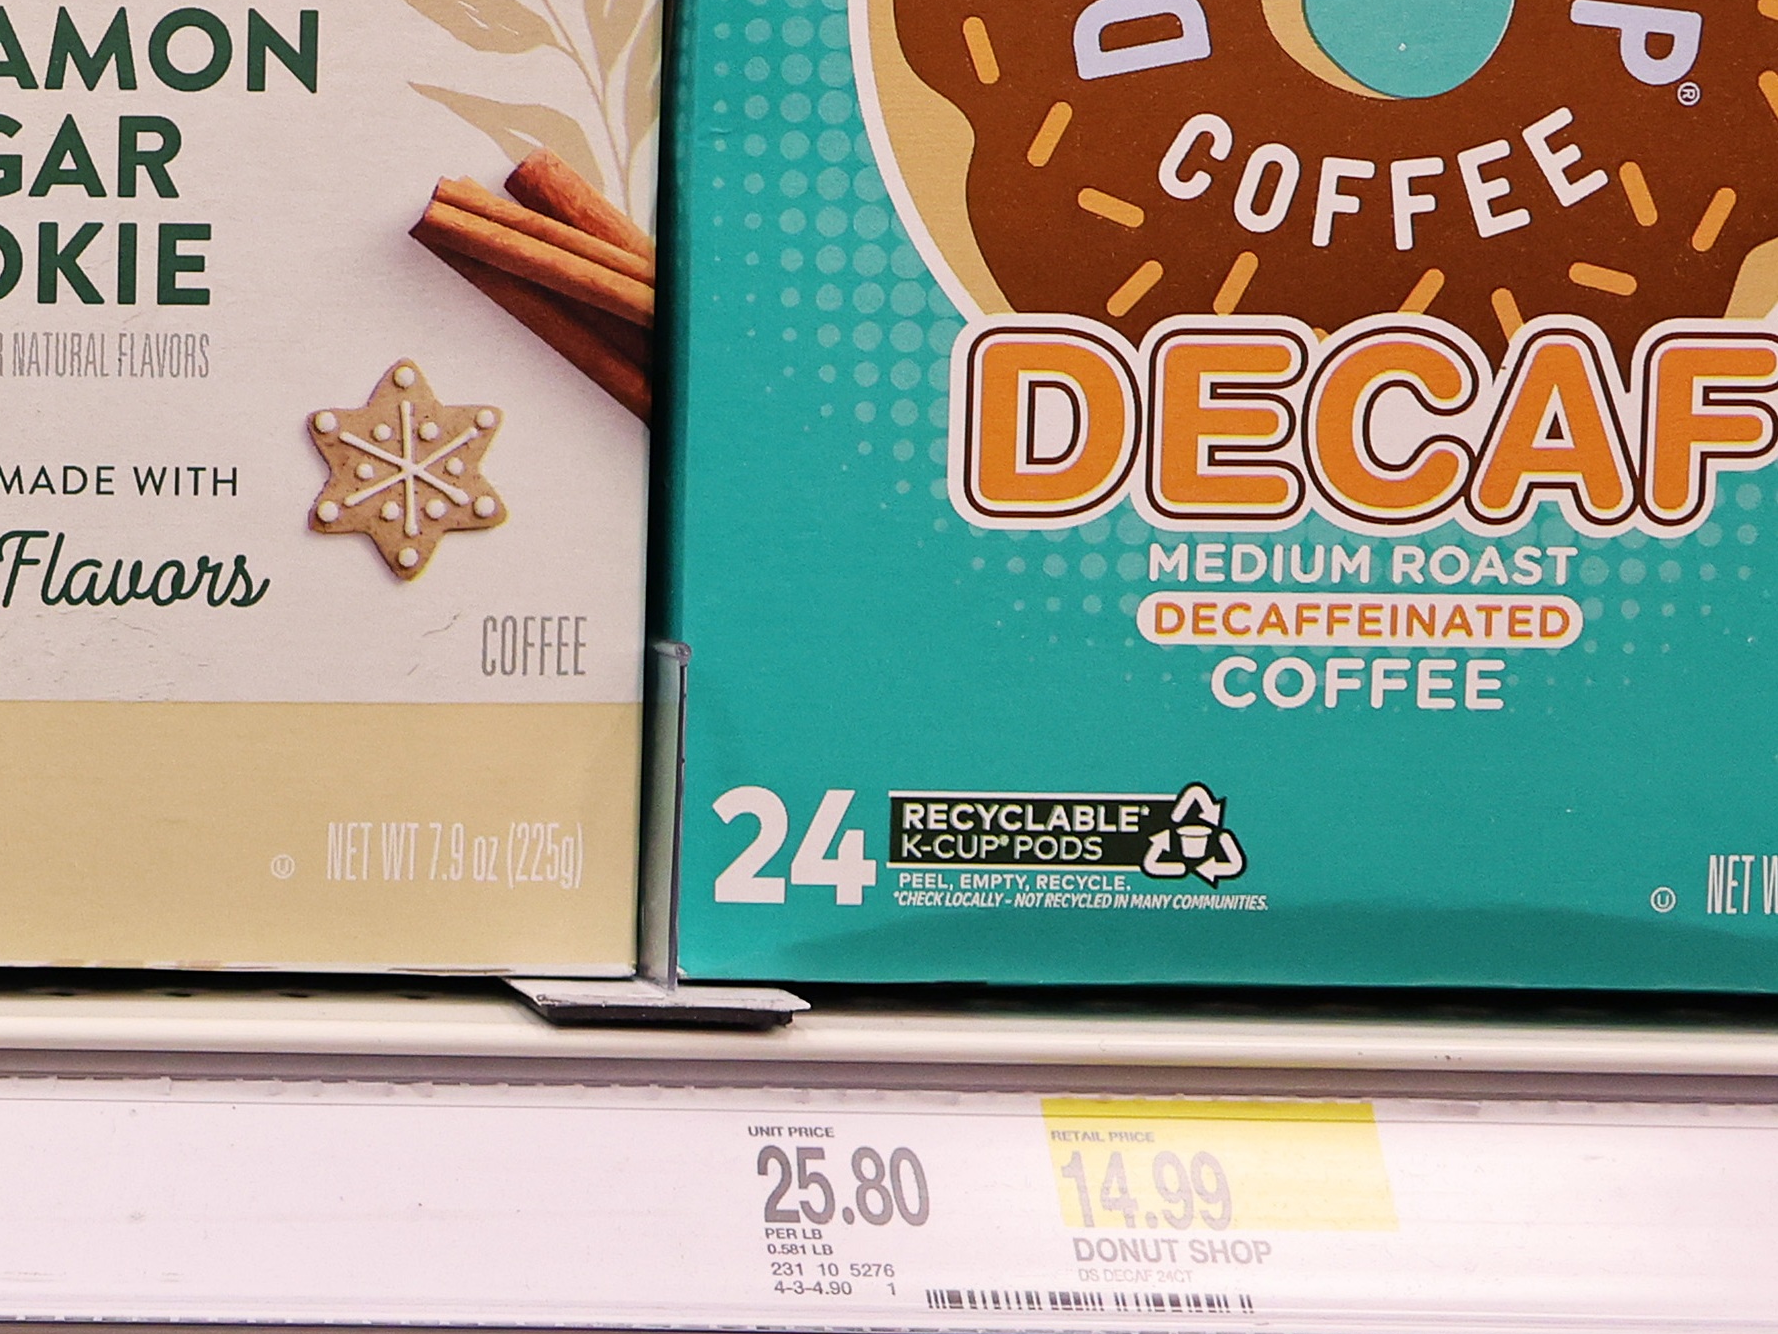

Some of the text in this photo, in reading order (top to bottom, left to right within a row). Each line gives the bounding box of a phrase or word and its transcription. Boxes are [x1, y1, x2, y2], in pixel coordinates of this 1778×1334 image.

[1157, 105, 1609, 251] COFFEE
[13, 331, 109, 377] NATURAL
[117, 333, 210, 378] FLAVORS
[964, 325, 1778, 526] DECAF
[132, 466, 238, 496] WITH
[1149, 542, 1579, 586] MEDIUM ROAST
[481, 615, 587, 676] COFFEE
[1153, 601, 1572, 640] DECAFFEINATED
[1210, 657, 1505, 710] COFFEE
[711, 785, 877, 905] 24
[748, 1126, 835, 1138] UNIT PRICE
[1051, 1131, 1155, 1142] RETAIL PRICE
[757, 1146, 930, 1228] 25.80
[1061, 1151, 1232, 1231] 14.99
[1073, 1238, 1271, 1264] DONUT SHOP
